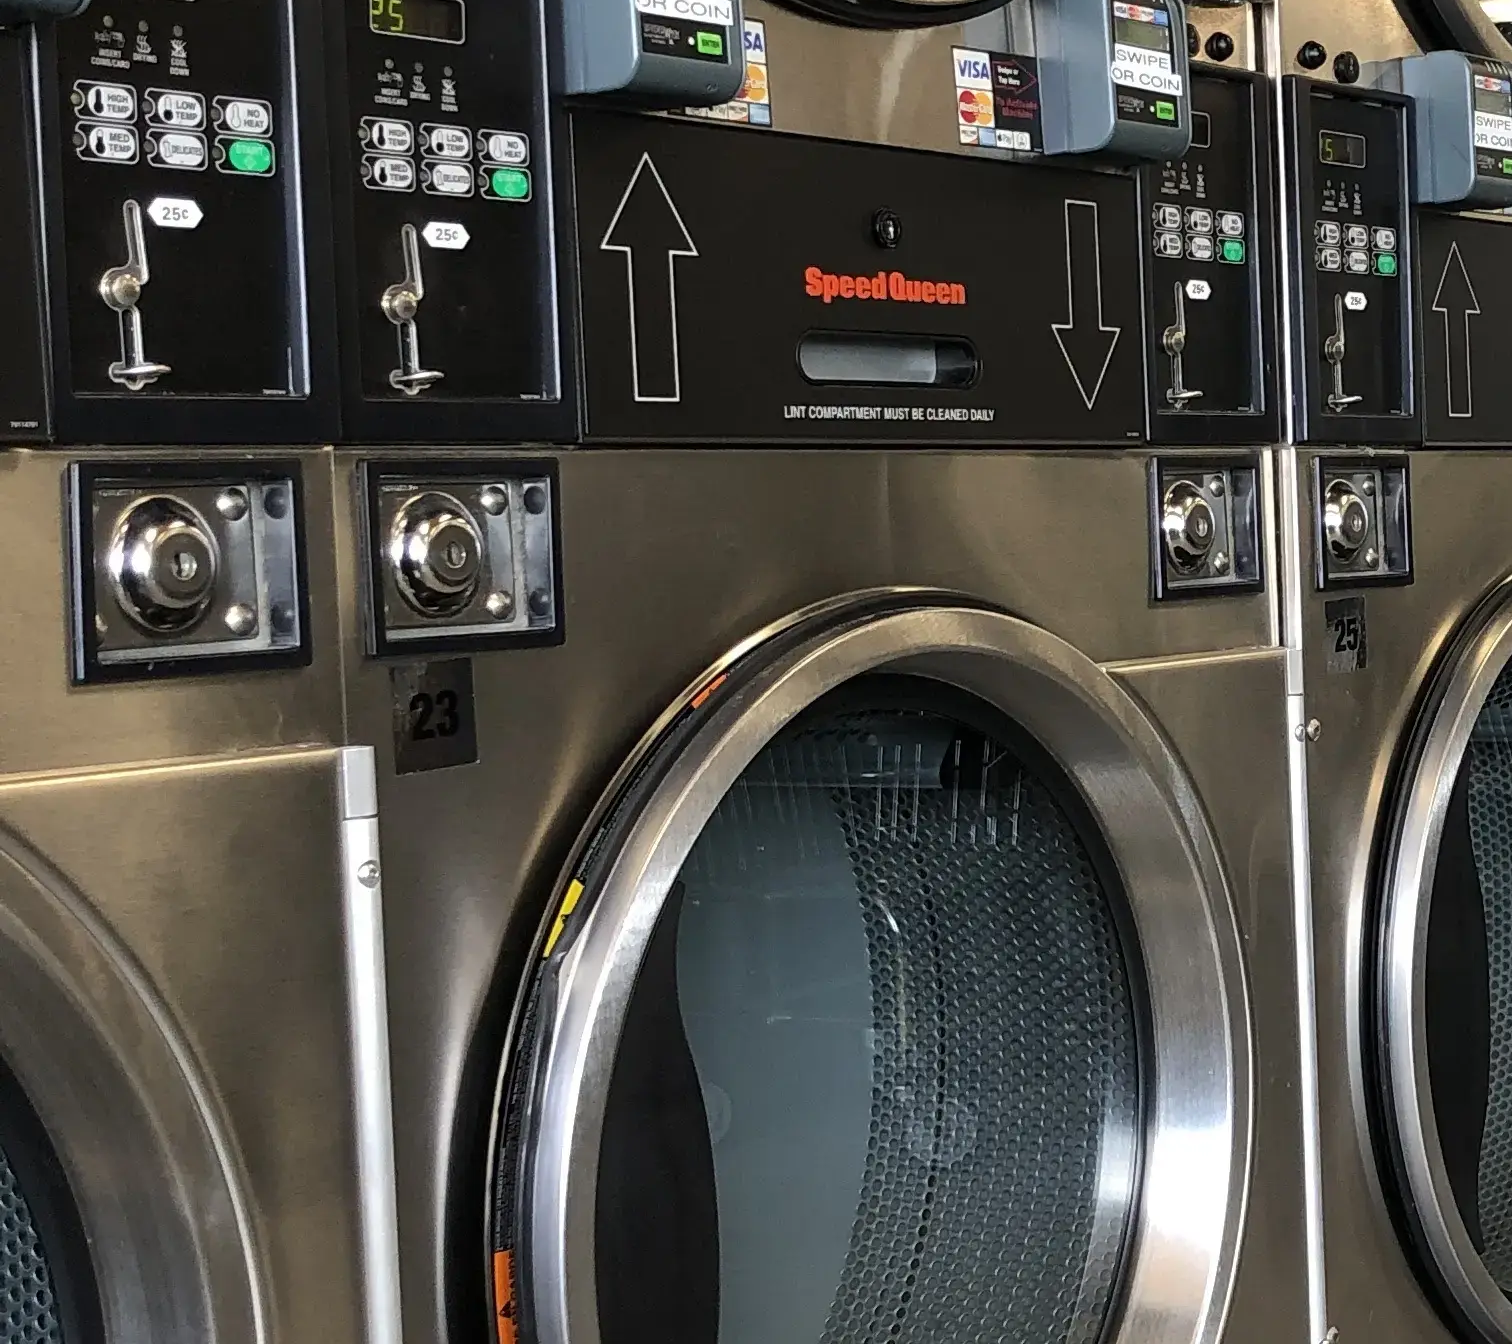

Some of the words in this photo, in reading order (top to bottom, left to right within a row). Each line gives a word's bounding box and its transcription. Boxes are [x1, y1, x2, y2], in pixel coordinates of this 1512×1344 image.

[674, 0, 731, 21] COIN
[744, 30, 764, 53] SA
[1115, 48, 1170, 71] SWIPE
[957, 59, 990, 80] VISA
[1111, 67, 1135, 82] OR
[1138, 73, 1180, 92] COIN
[106, 93, 129, 104] HIGH
[175, 99, 196, 111] LOW
[106, 104, 130, 114] TEMP
[175, 111, 198, 121] TEMP
[246, 109, 261, 118] NO
[243, 119, 265, 129] HEAT
[1475, 116, 1512, 132] SWIPE
[108, 132, 130, 143] MED
[108, 143, 132, 154] TEMP
[161, 206, 190, 222] 25¢
[435, 228, 459, 242] 25¢
[784, 405, 807, 419] LINT
[808, 406, 881, 421] COMPARTMENT
[884, 407, 910, 421] MUST
[911, 408, 925, 421] BE
[926, 408, 969, 422] CLEANED
[970, 409, 995, 422] DAILY
[1334, 618, 1360, 653] 25
[409, 689, 460, 741] 23
